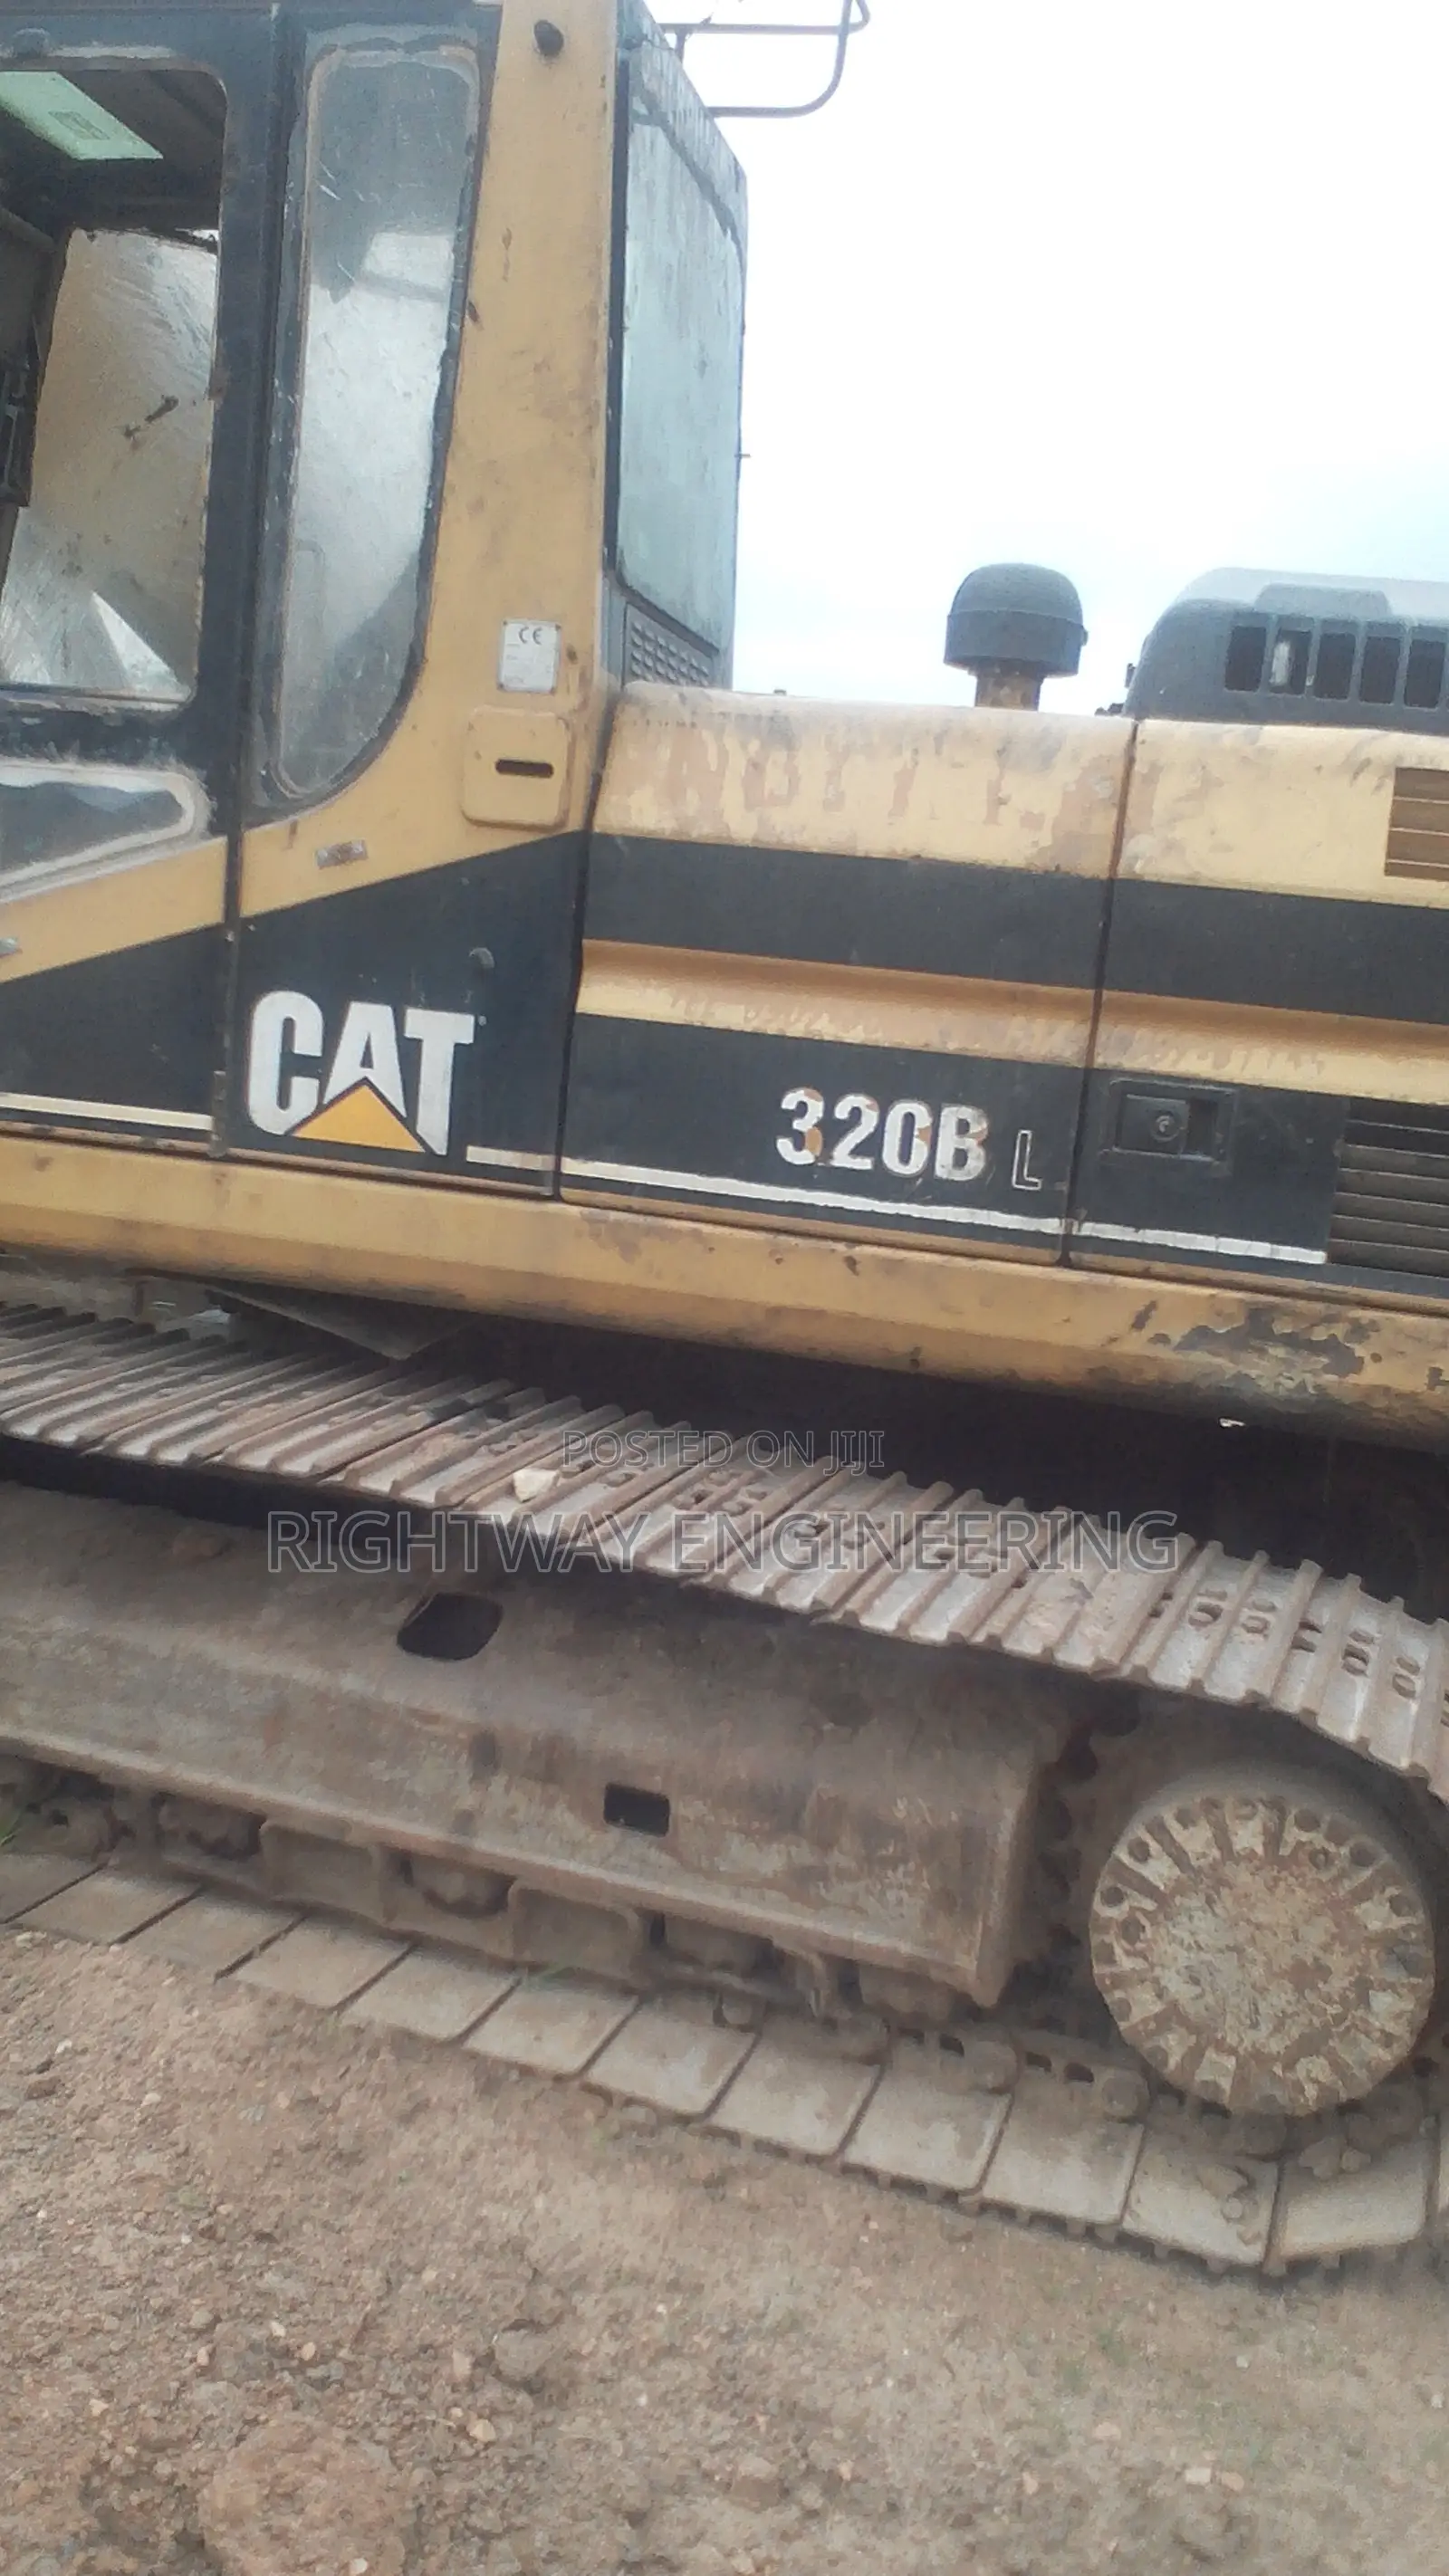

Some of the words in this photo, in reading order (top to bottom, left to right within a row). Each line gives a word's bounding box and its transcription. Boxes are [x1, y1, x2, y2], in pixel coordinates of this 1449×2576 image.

[518, 627, 542, 646] CE
[247, 991, 475, 1156] CAT
[775, 1087, 989, 1182] 320B
[1011, 1129, 1042, 1191] L
